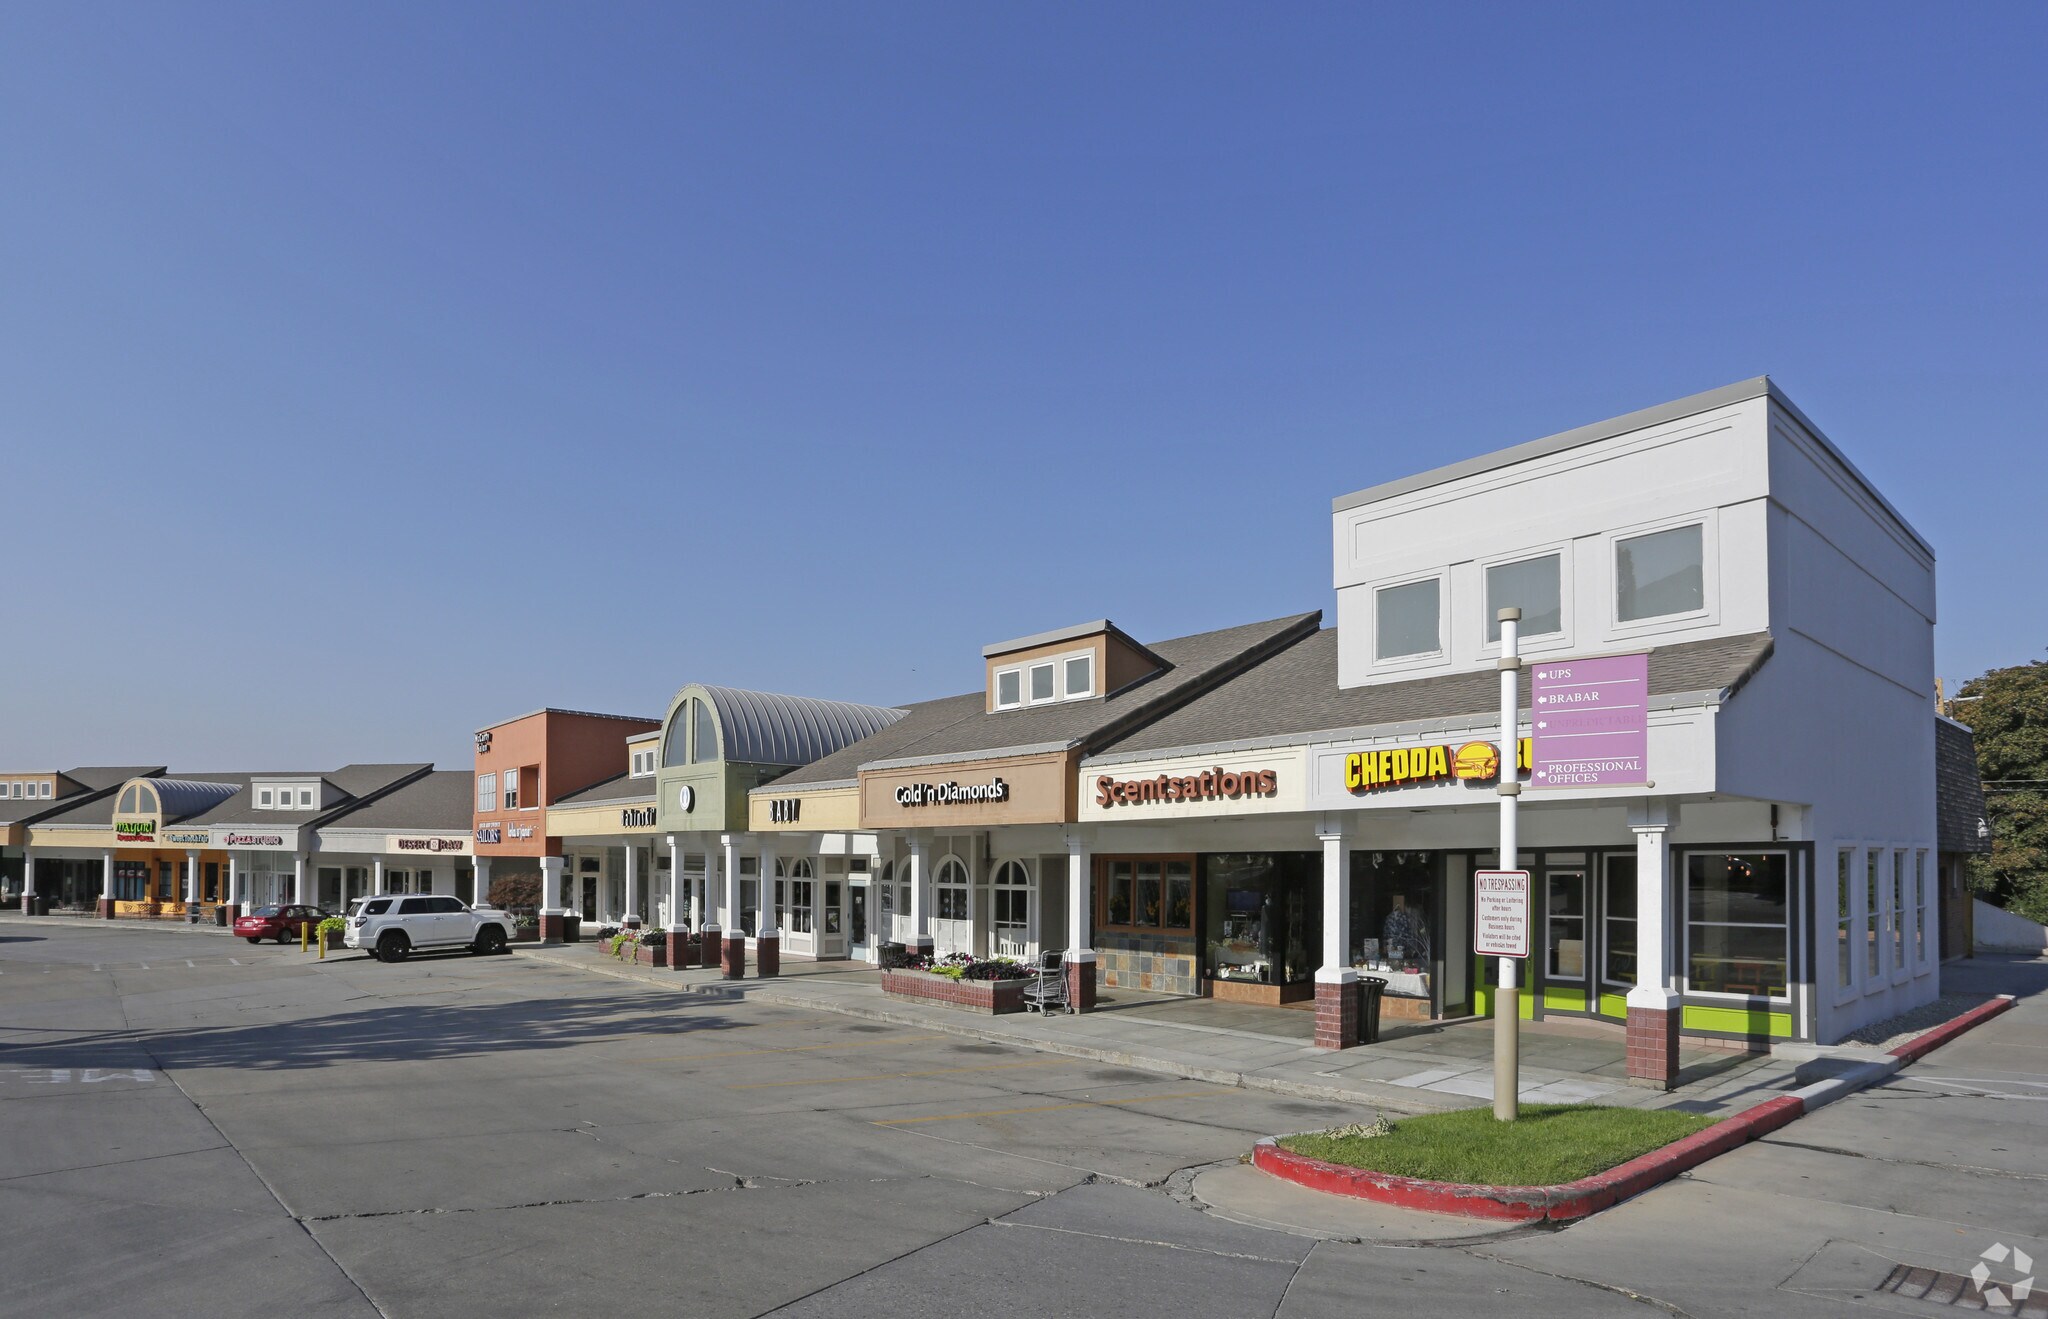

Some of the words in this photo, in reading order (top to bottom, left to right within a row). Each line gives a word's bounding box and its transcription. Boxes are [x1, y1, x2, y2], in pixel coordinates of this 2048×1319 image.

[1549, 669, 1572, 679] UPS
[1549, 691, 1600, 704] BRABAR
[1345, 745, 1449, 790] CHEDDA
[1548, 761, 1642, 774] PROFESSIONAL
[1548, 773, 1598, 784] OFFICES
[937, 777, 1003, 801] Diamonds
[1096, 766, 1276, 806] Scentsations
[769, 799, 798, 821] BABY
[440, 840, 463, 850] RAW
[1480, 879, 1487, 890] NO
[1488, 879, 1525, 890] TRESPASSING
